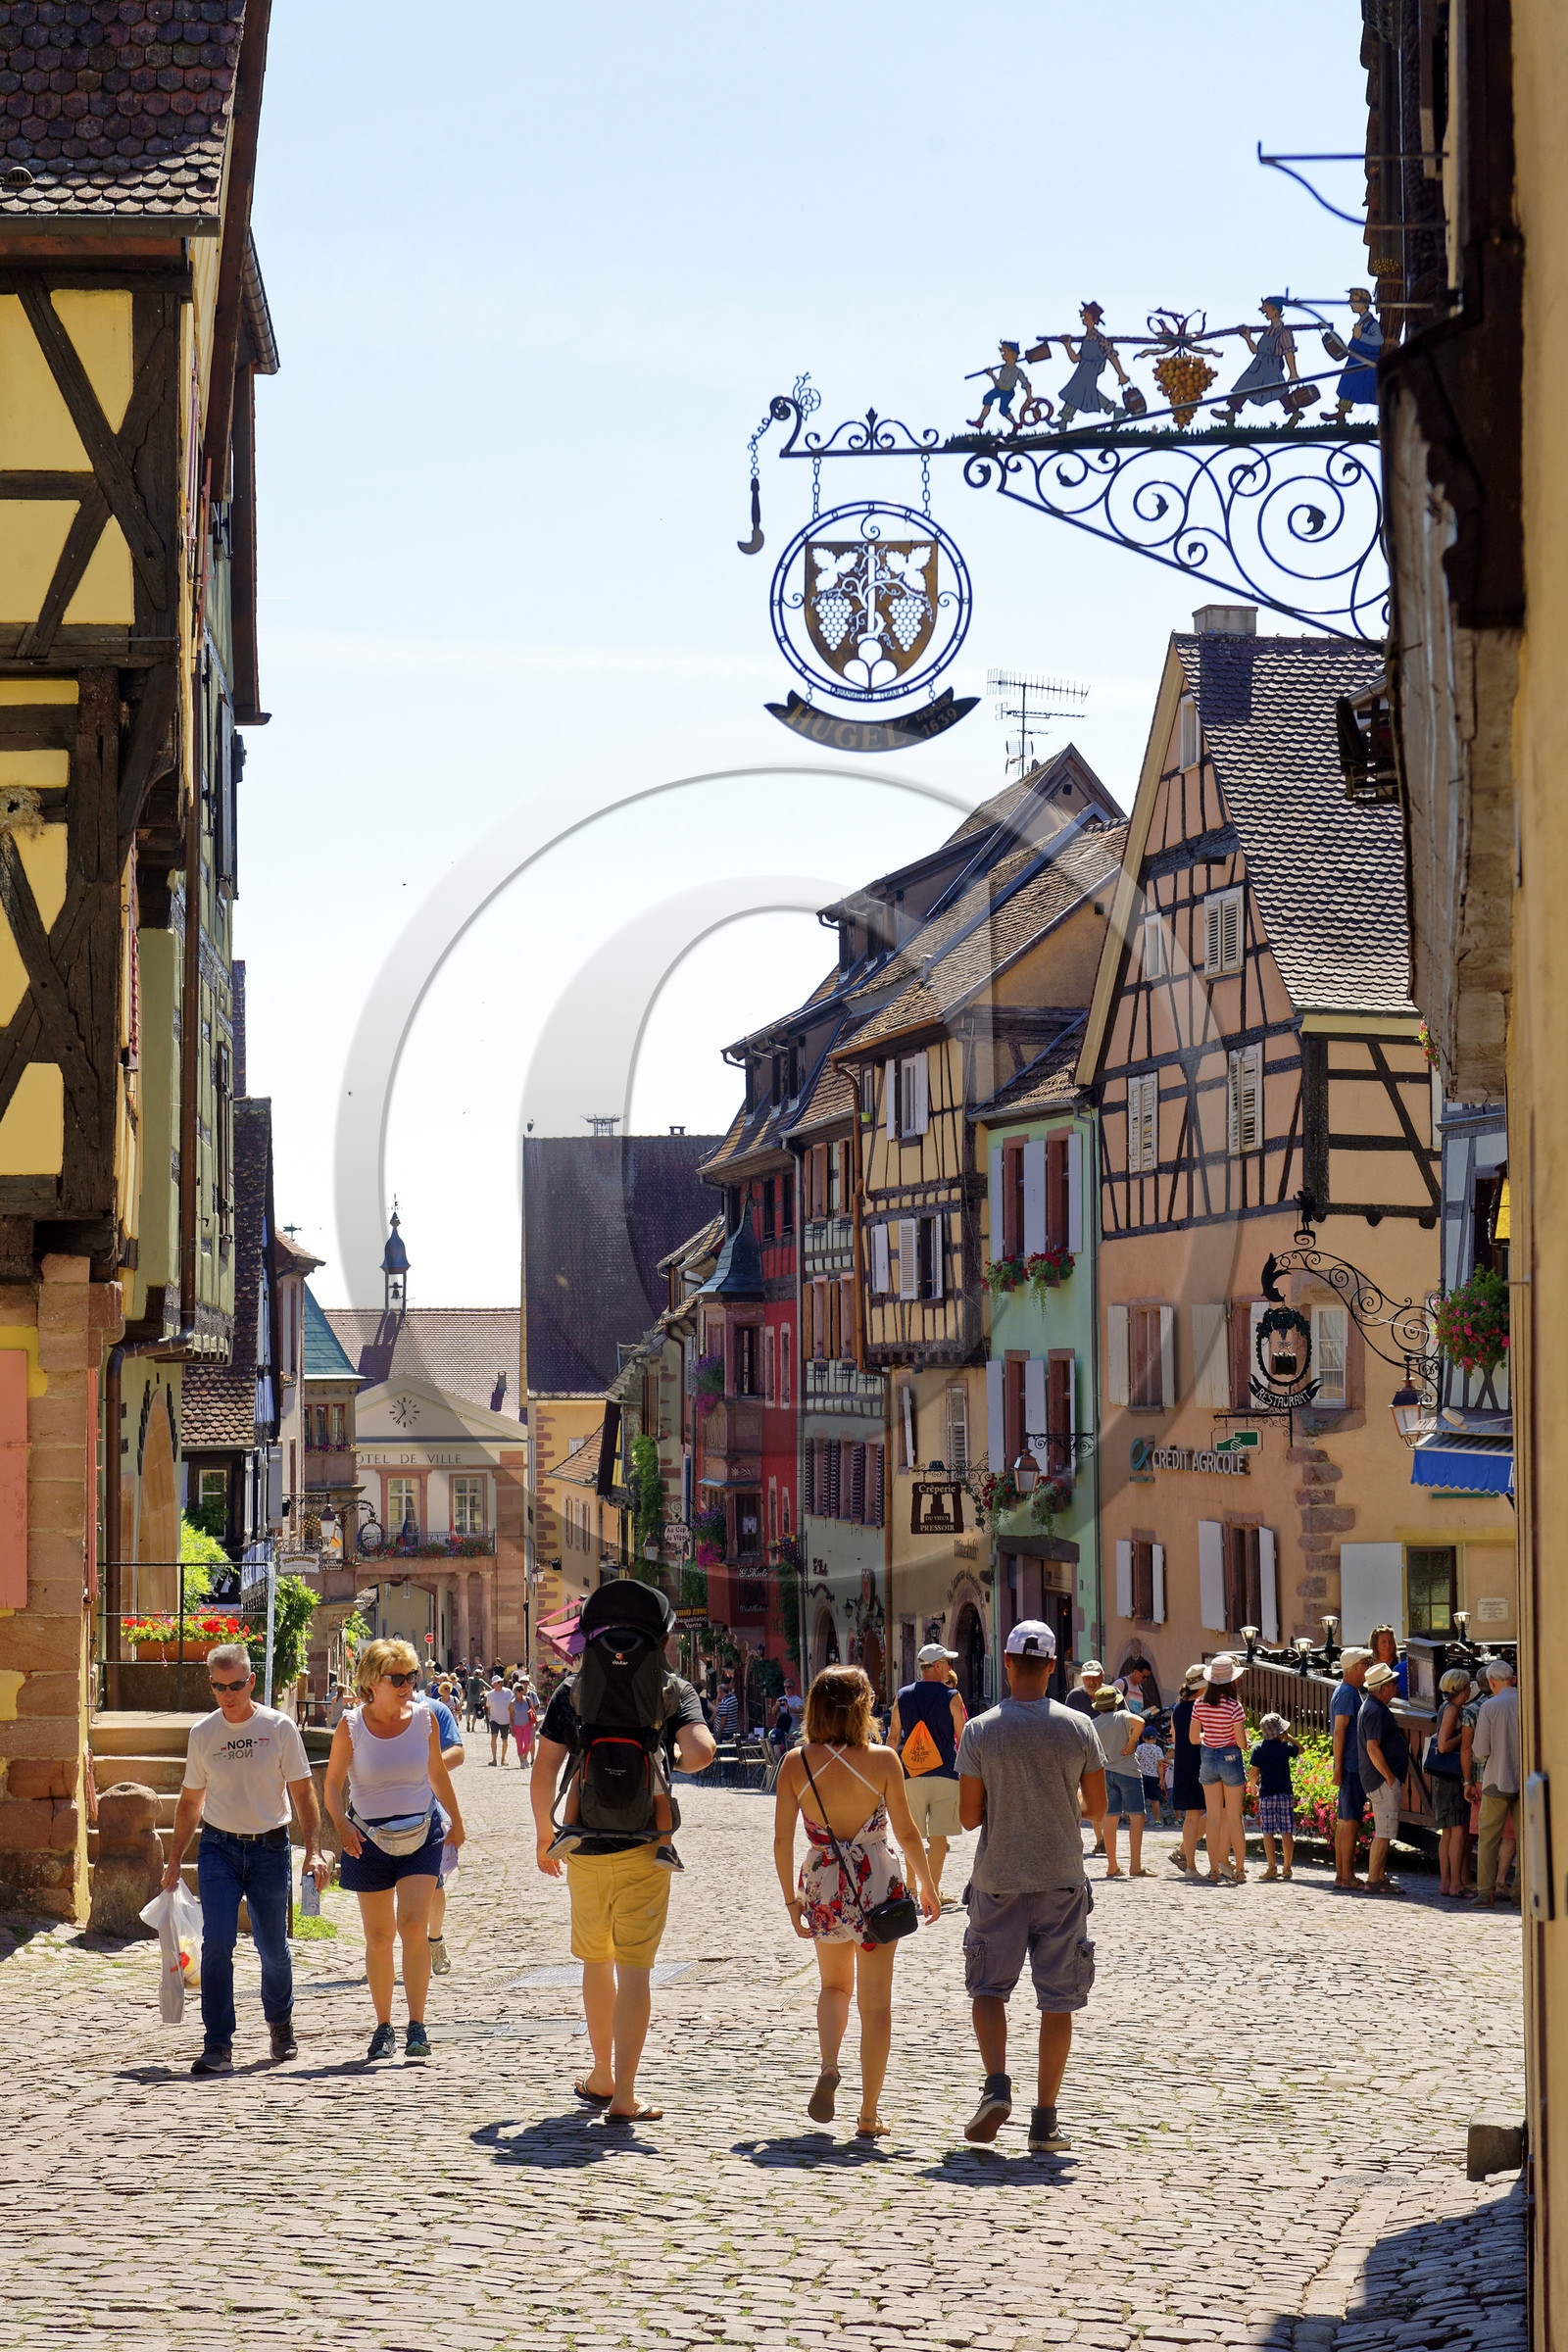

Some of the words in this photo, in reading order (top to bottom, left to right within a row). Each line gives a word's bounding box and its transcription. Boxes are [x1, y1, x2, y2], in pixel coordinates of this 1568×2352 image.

[915, 696, 951, 722] DEPUIS
[921, 707, 958, 736] 1639
[1255, 1387, 1312, 1408] RESTAURANT
[400, 1453, 417, 1464] DE
[427, 1453, 463, 1464] VILLE
[1152, 1446, 1189, 1470] CRÉDIT
[1192, 1451, 1248, 1476] AGRICOLE
[918, 1484, 956, 1494] Crêperie
